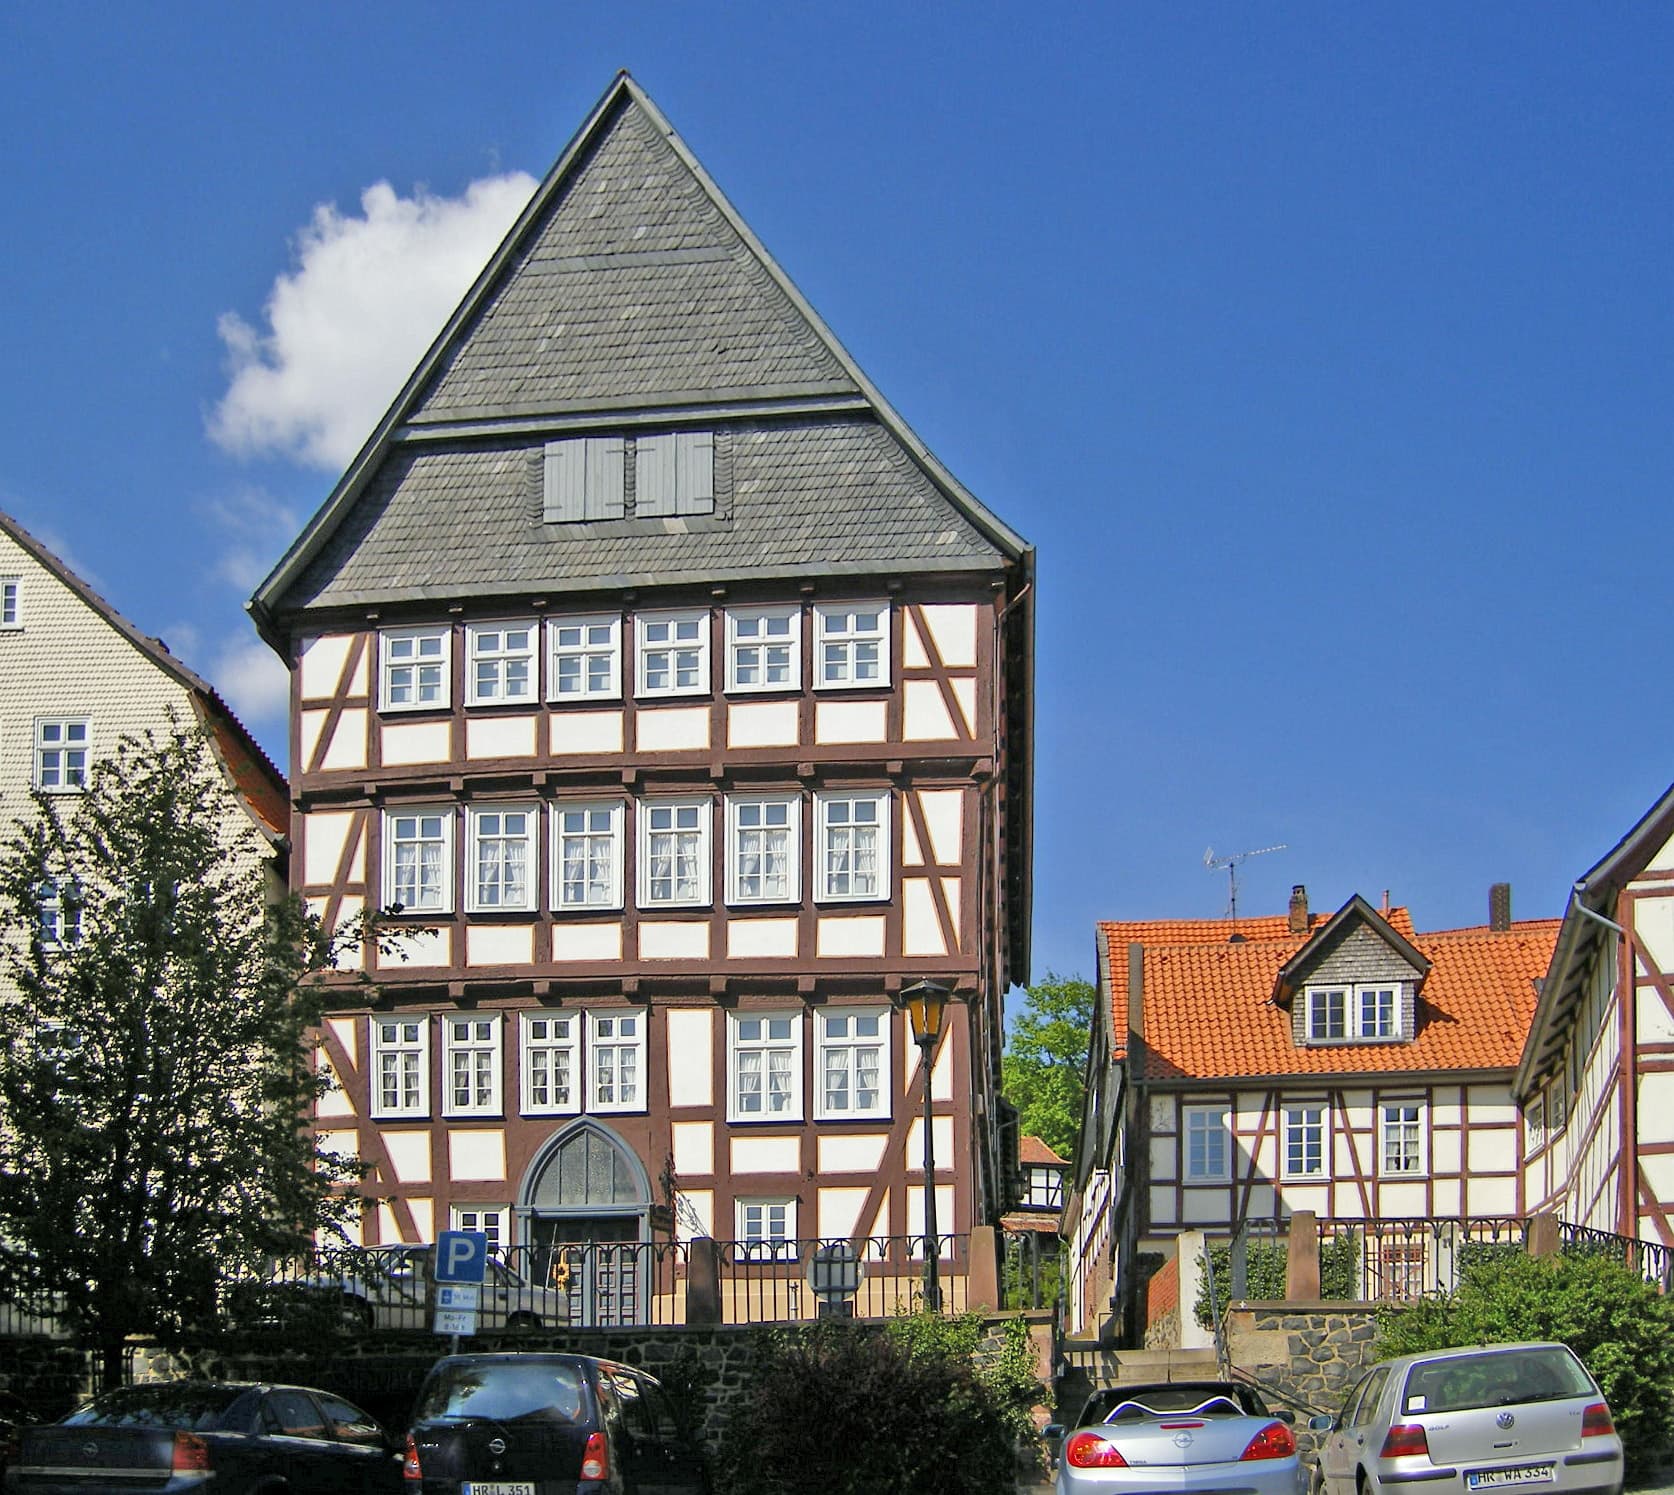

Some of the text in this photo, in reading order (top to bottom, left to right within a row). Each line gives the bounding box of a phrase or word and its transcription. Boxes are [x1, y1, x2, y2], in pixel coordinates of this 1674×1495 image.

[447, 1238, 476, 1276] P
[1478, 1471, 1496, 1483] HR
[1504, 1468, 1522, 1481] WA
[473, 1485, 531, 1495] HR L 351
